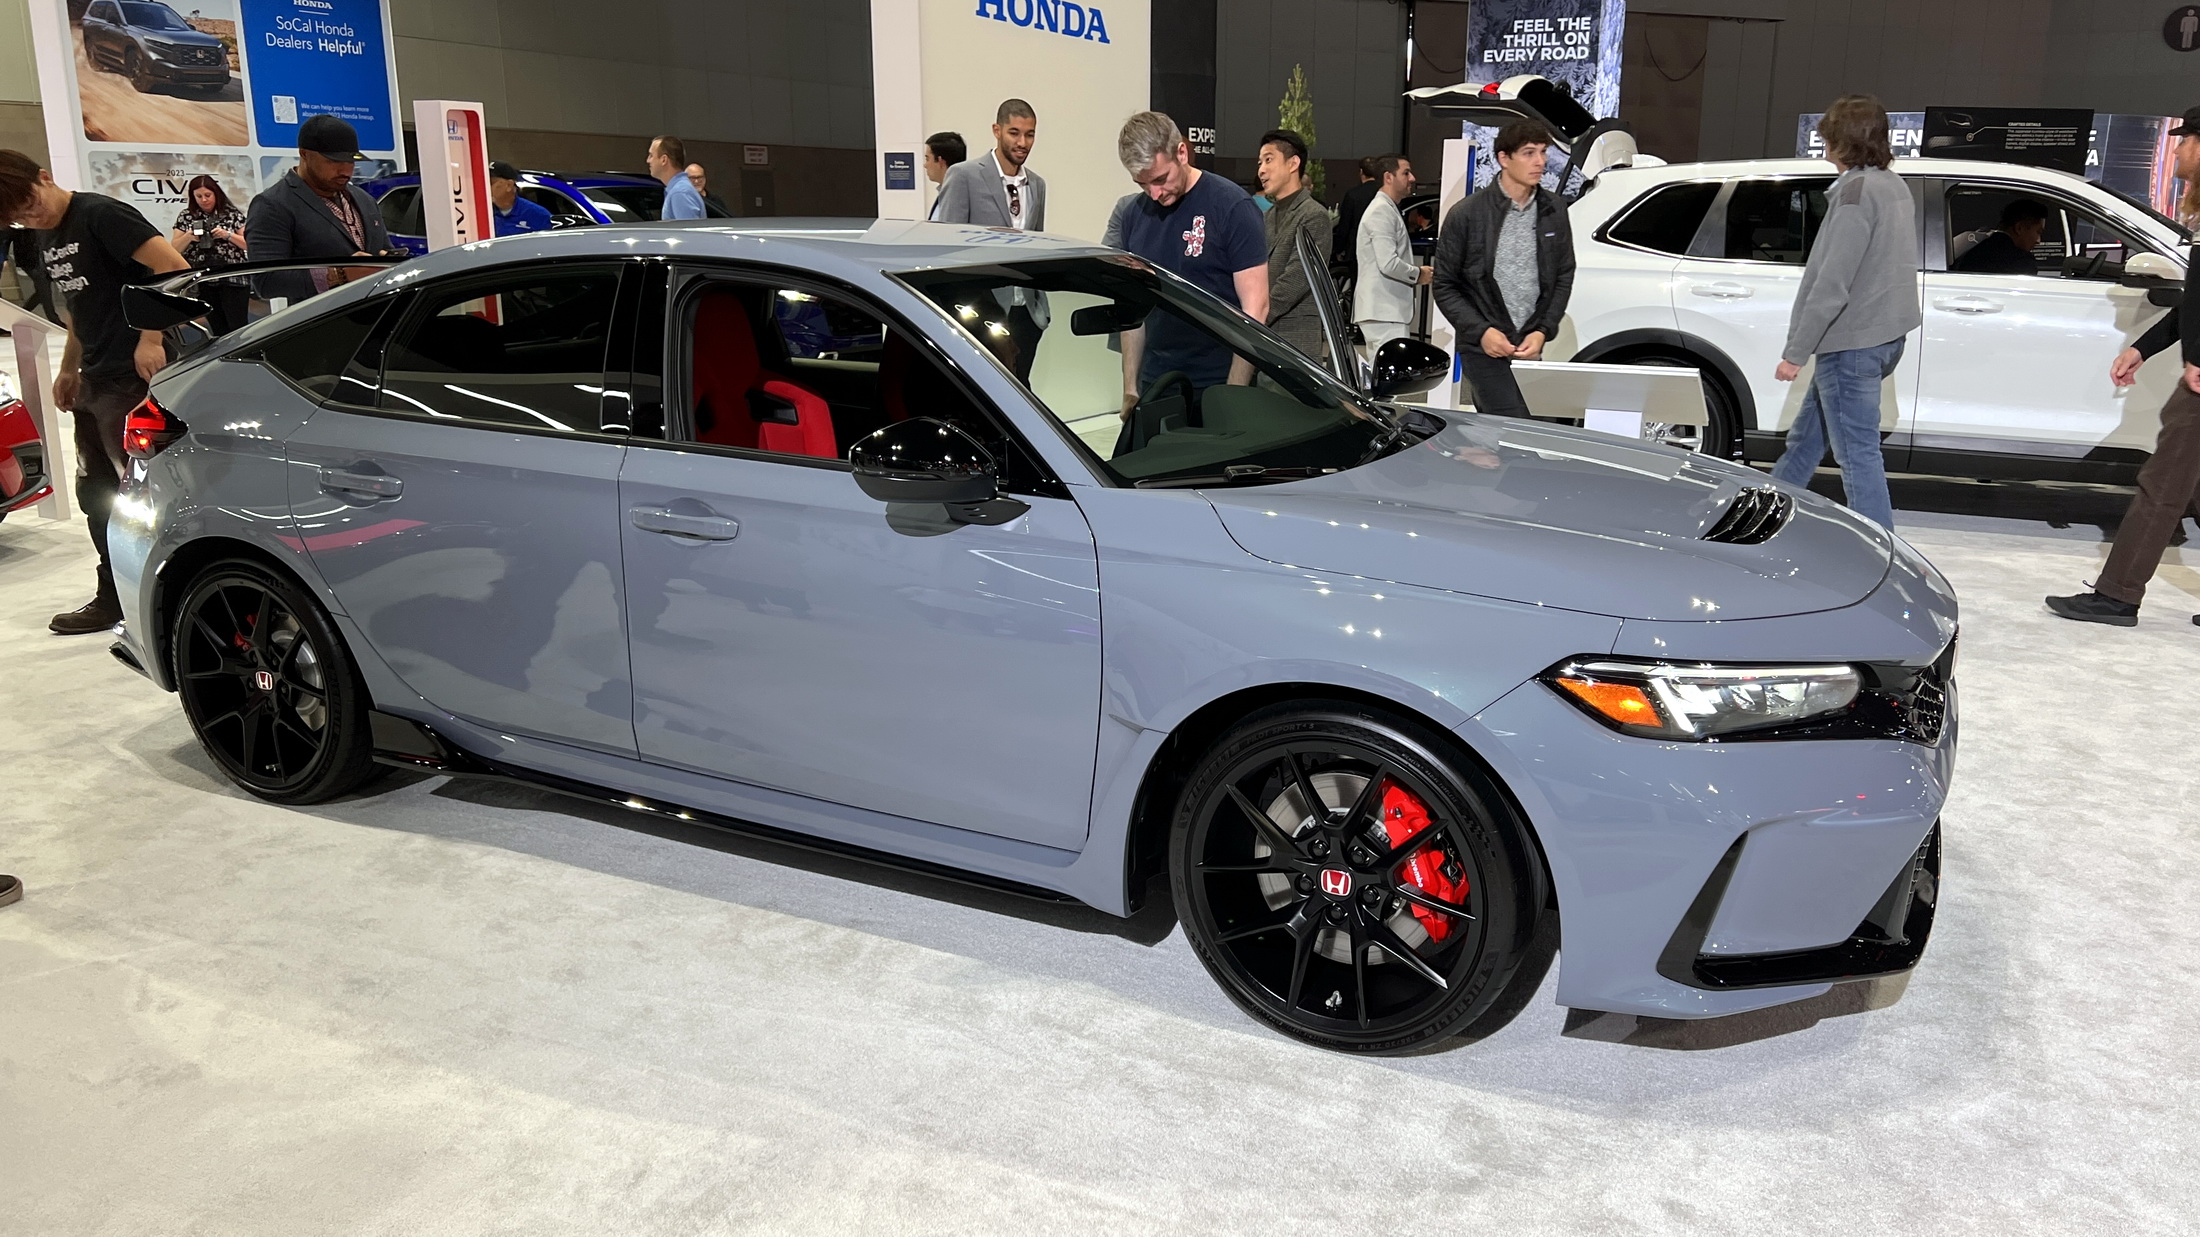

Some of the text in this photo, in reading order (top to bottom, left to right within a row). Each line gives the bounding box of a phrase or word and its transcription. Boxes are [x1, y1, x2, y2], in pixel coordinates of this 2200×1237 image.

[293, 0, 333, 10] HONDA
[276, 15, 354, 37] SoCal Honda
[975, 0, 1110, 44] HONDA
[1513, 16, 1591, 33] FEEL THE
[265, 32, 313, 50] Dealers
[1503, 31, 1590, 47] THRILL ON
[1483, 46, 1589, 62] EVERY ROAD
[166, 169, 185, 177] 2023
[132, 179, 188, 195] CIV
[453, 175, 467, 244] IVIC
[1272, 723, 1302, 735] SPORT
[1410, 858, 1424, 888] brembo
[1423, 973, 1488, 1037] MICHELIN
